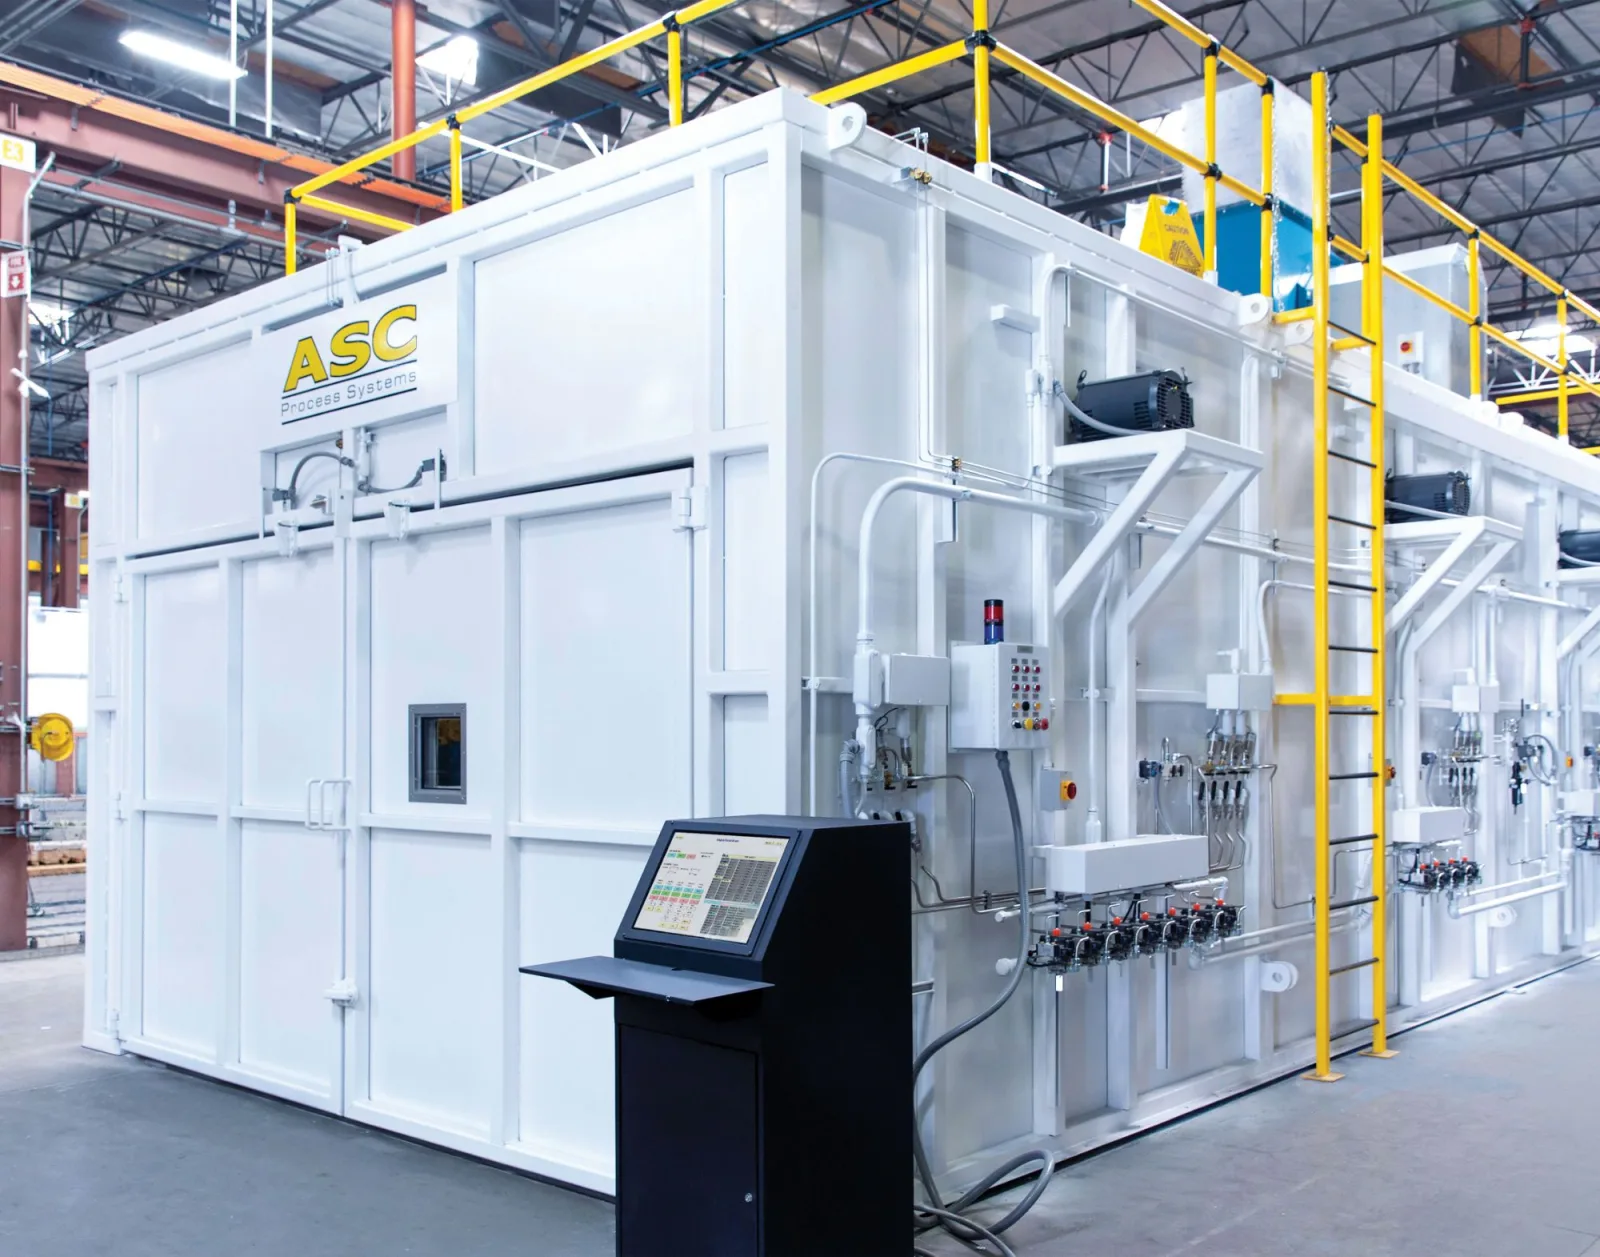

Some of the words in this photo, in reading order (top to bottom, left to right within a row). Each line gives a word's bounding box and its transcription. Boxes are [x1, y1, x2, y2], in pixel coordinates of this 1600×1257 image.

[2, 139, 24, 163] E3
[283, 304, 418, 393] ASC
[281, 391, 340, 416] Process
[346, 371, 417, 399] Systems
